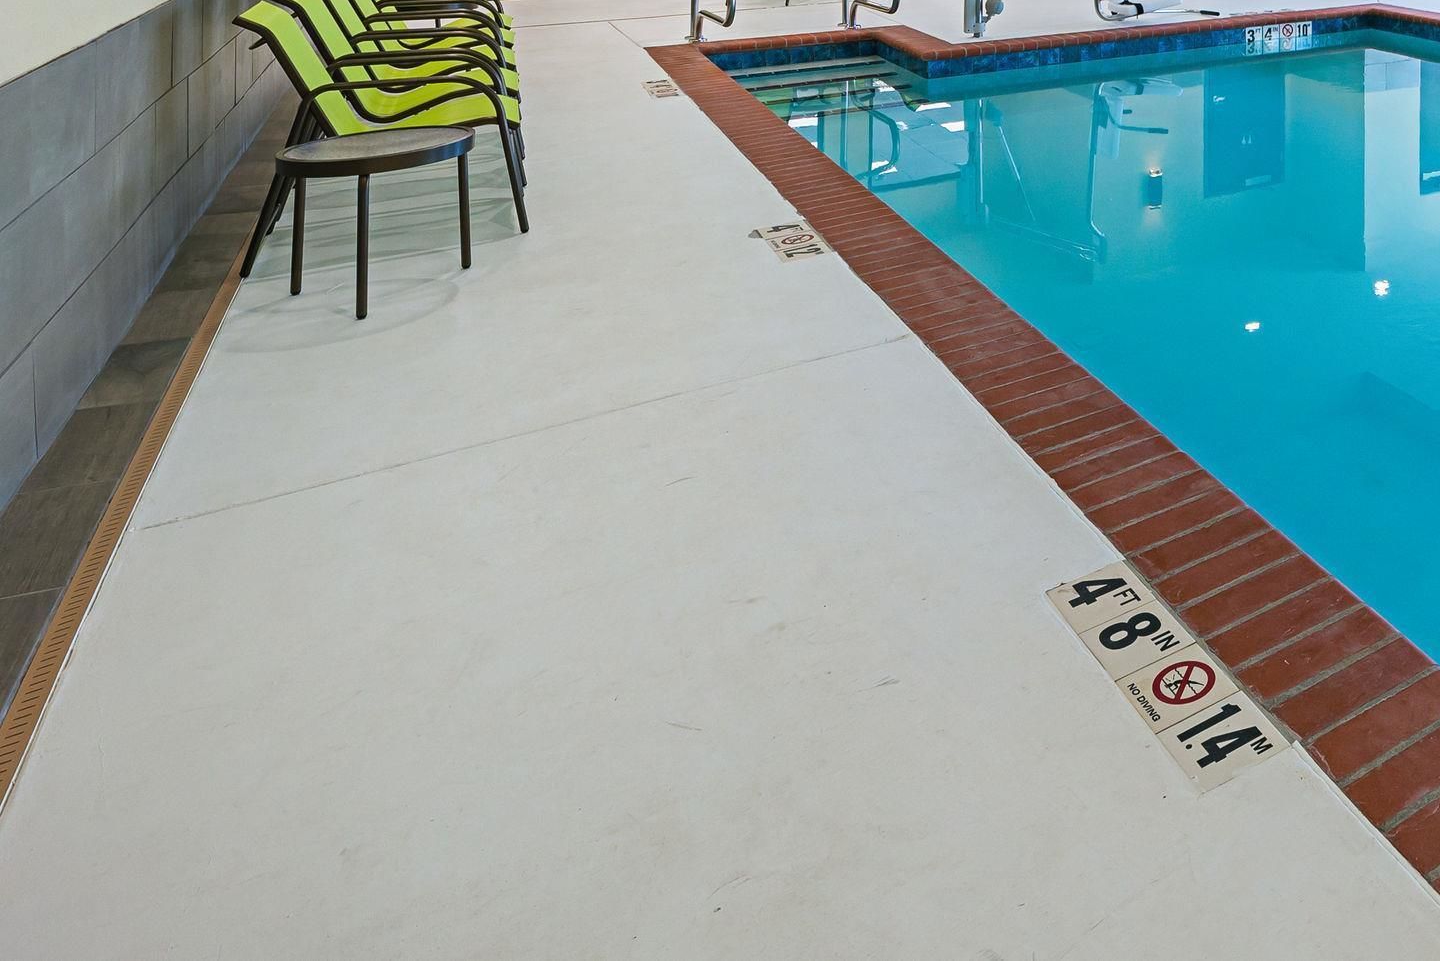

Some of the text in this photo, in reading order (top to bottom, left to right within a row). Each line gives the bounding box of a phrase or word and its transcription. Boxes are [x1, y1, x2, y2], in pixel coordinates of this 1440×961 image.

[1247, 29, 1255, 43] 3
[1264, 27, 1272, 41] 4
[1297, 23, 1308, 37] 10
[1068, 577, 1274, 769] 4 FT 8 IN 1.4 M
[1127, 682, 1161, 723] NO DIVING
